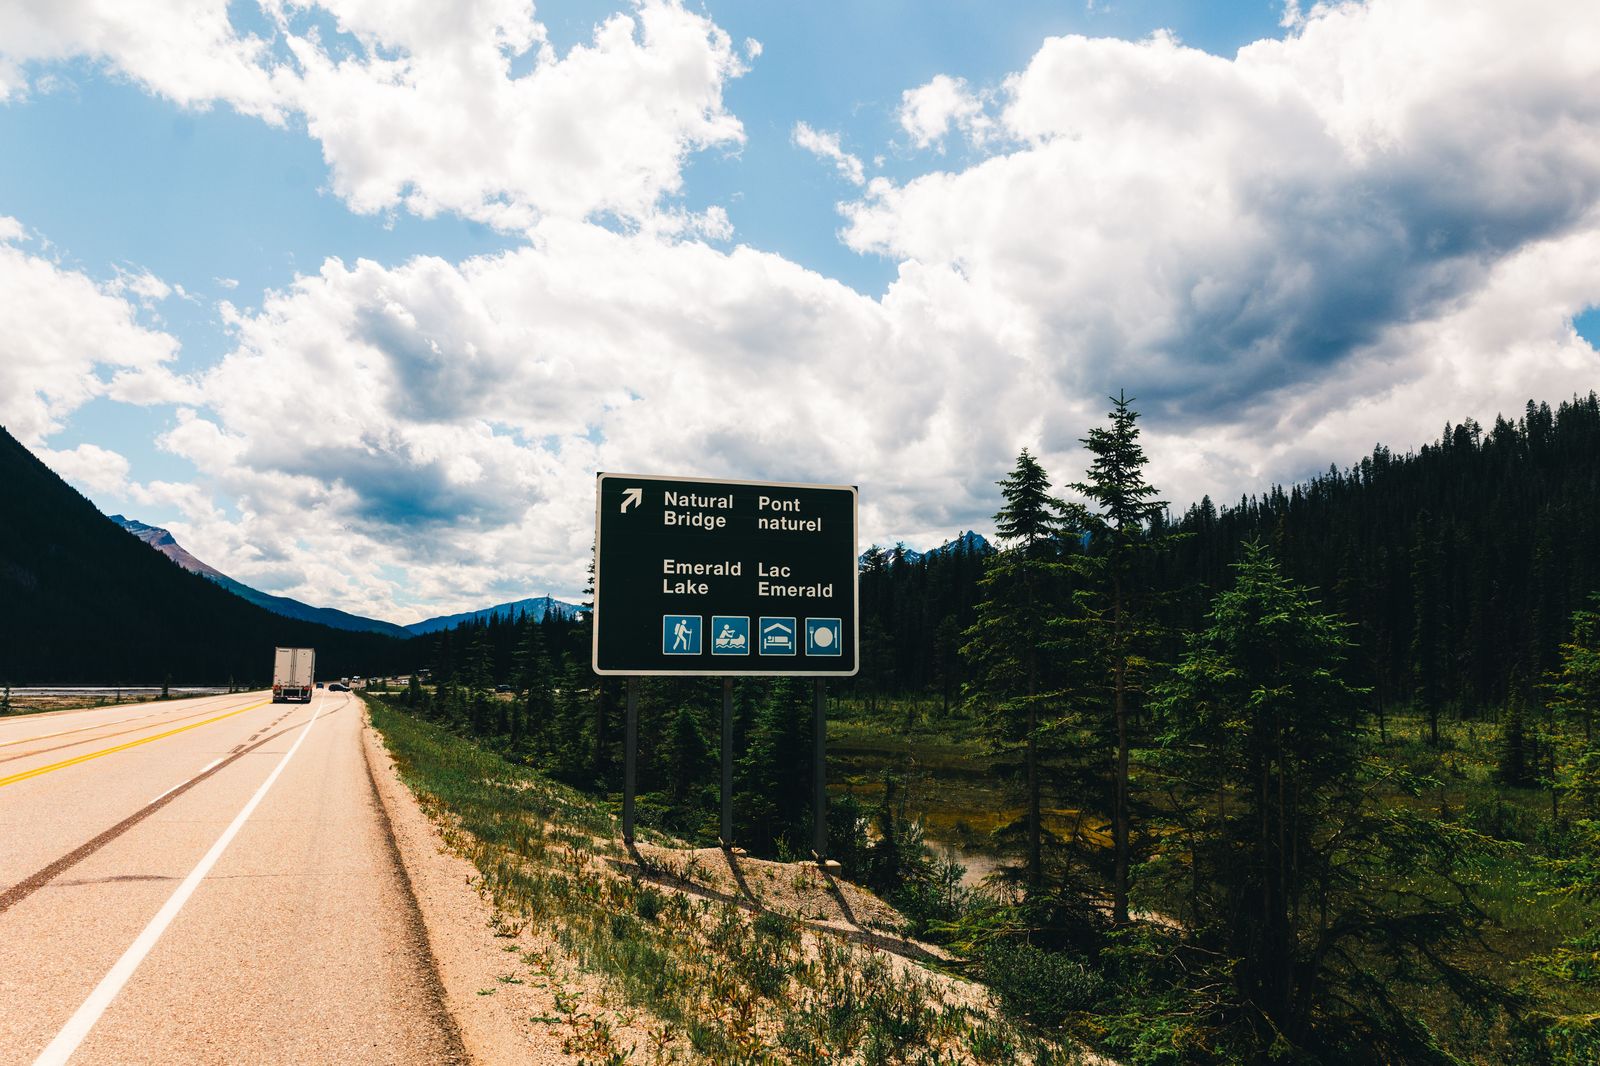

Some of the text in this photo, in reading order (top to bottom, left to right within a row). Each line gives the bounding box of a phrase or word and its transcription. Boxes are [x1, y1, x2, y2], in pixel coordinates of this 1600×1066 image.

[664, 491, 733, 509] Natural
[758, 495, 801, 512] Pont
[664, 510, 727, 531] Bridge
[758, 517, 822, 532] naturel
[663, 559, 742, 576] Emerald
[758, 562, 791, 578] Lac
[663, 579, 709, 595] Lake
[758, 581, 833, 598] Emerald
